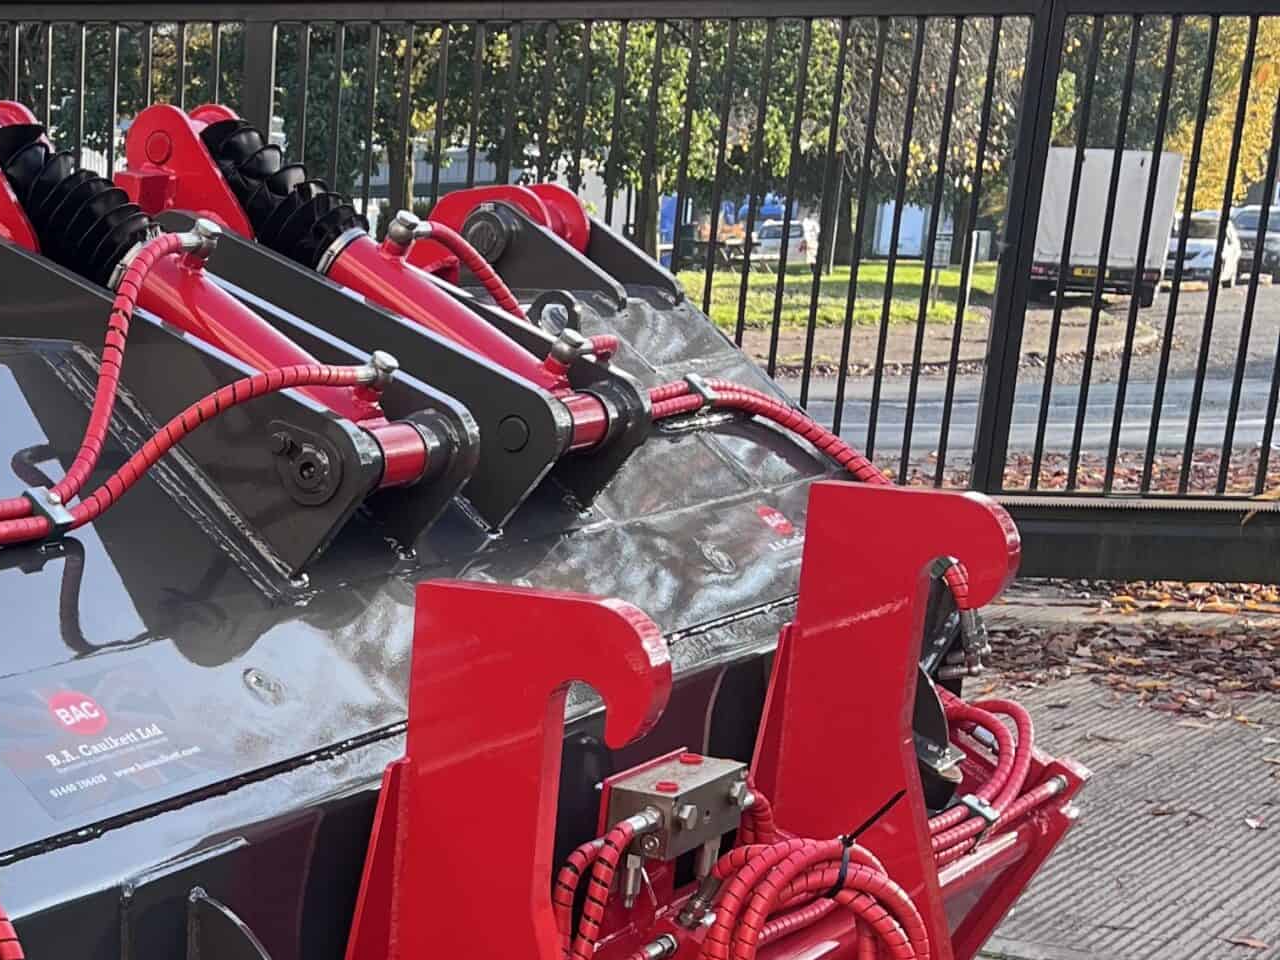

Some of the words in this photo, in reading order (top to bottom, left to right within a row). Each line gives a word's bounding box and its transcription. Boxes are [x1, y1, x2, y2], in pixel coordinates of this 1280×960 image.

[55, 701, 100, 726] BAC
[45, 750, 80, 767] B.A.
[78, 731, 139, 757] Caulkett
[136, 723, 164, 739] Ltd
